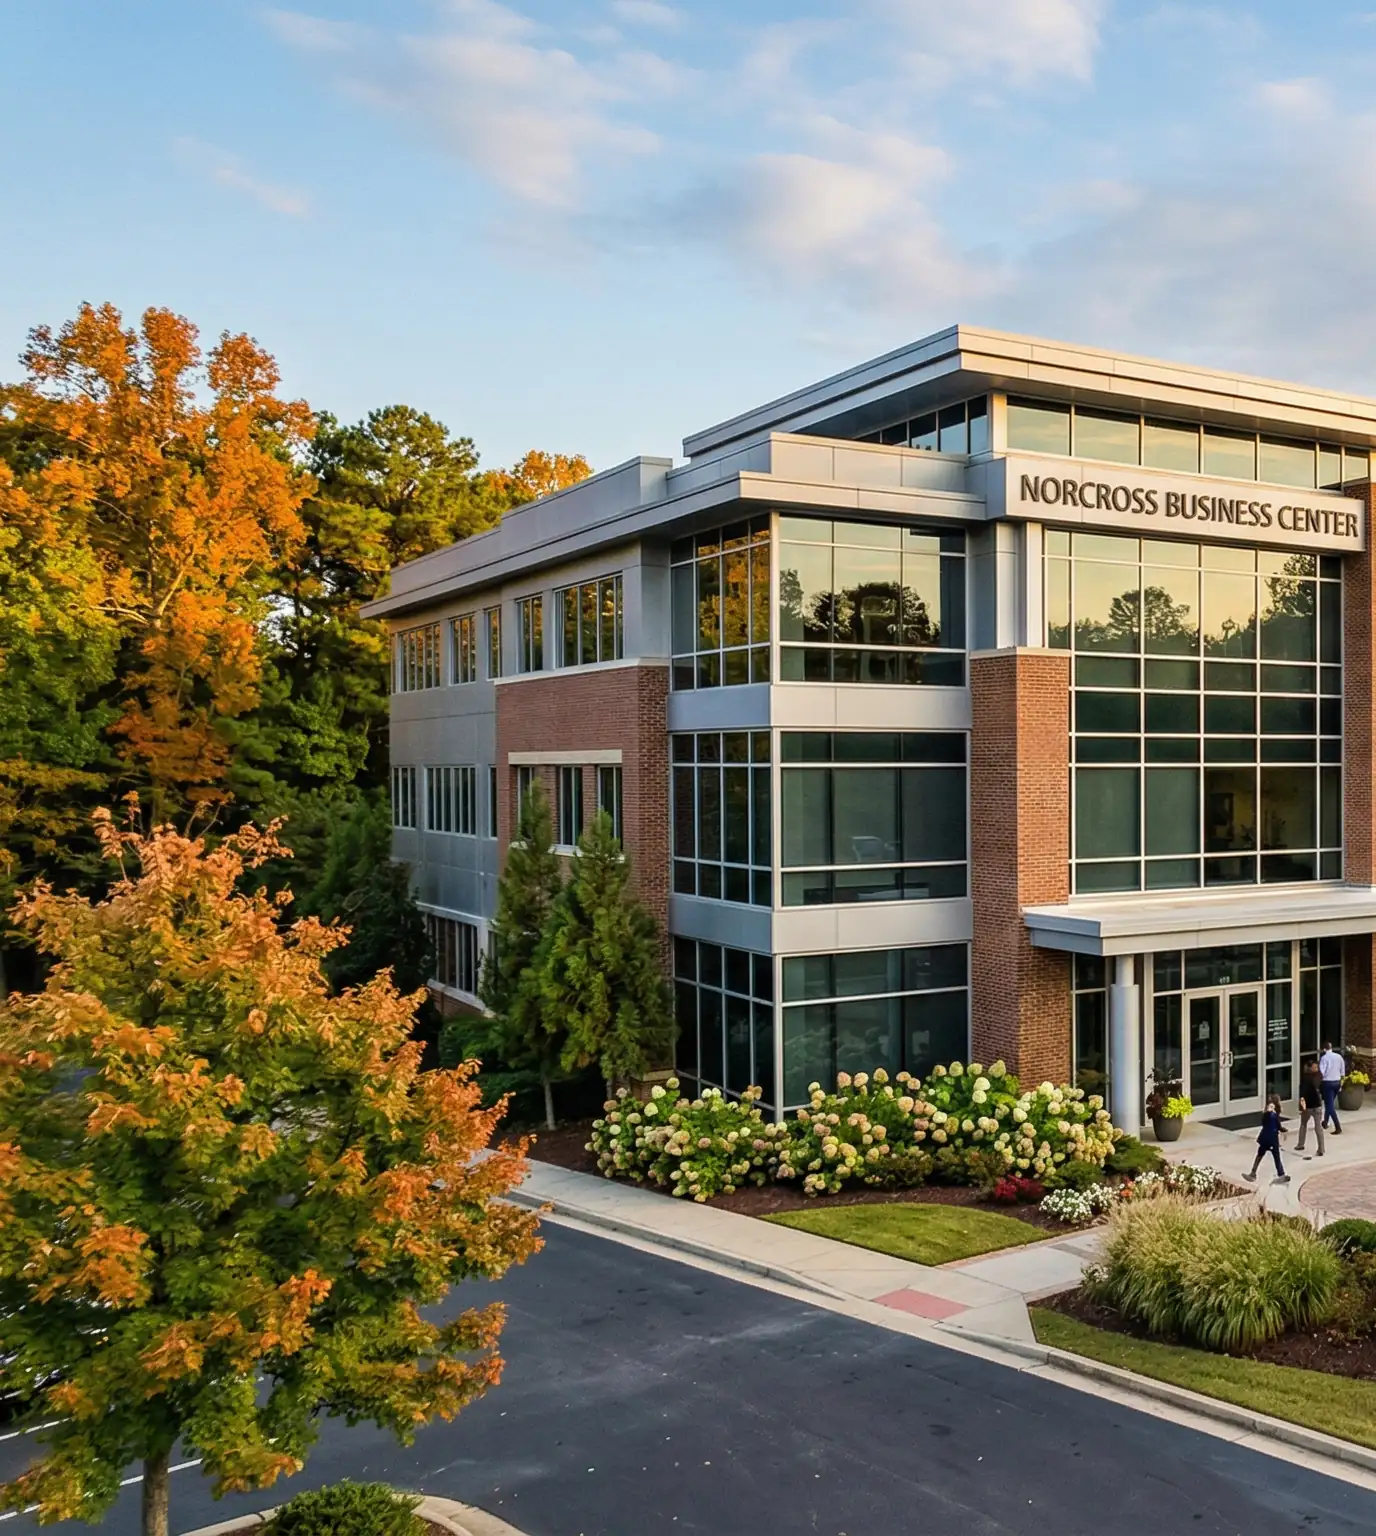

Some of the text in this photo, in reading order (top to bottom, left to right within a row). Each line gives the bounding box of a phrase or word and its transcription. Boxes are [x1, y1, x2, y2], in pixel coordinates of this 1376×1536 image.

[1021, 474, 1359, 537] NORCROSS BUSINESS CENTER
